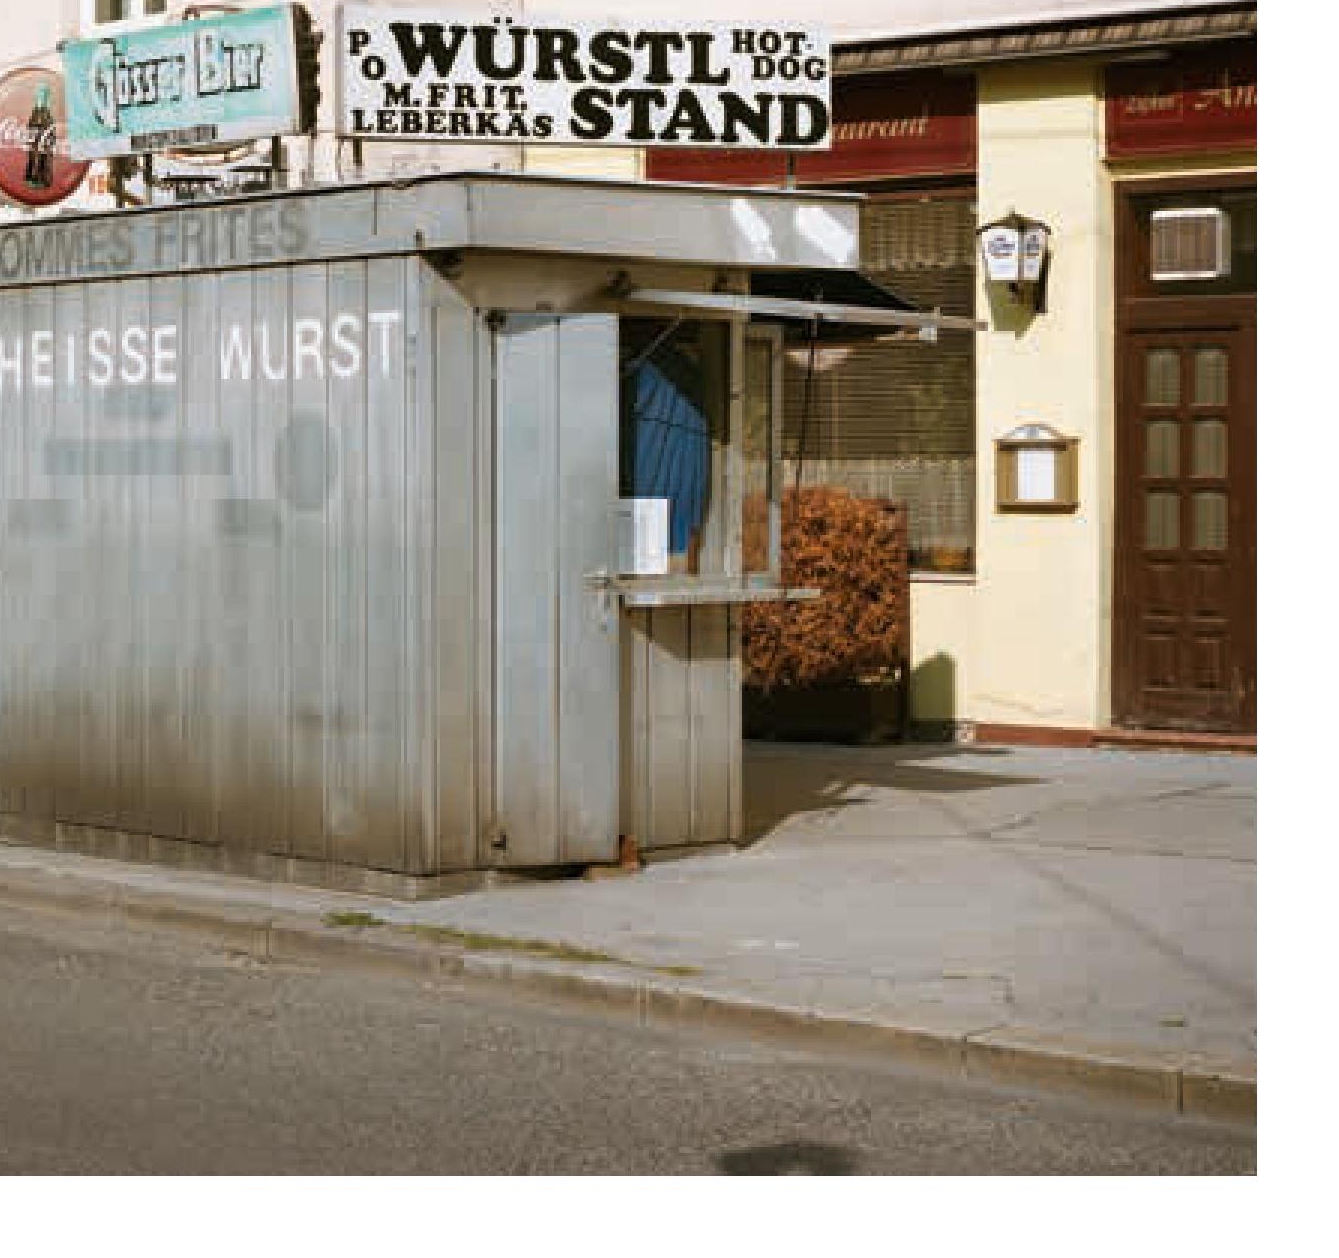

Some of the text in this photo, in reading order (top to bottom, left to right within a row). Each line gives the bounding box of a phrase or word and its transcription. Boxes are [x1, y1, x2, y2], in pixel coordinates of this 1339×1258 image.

[389, 17, 730, 85] WÜRSTL
[753, 56, 827, 81] DOG
[569, 87, 829, 145] STAND
[154, 200, 308, 267] FRITES
[220, 310, 403, 383] WURST
